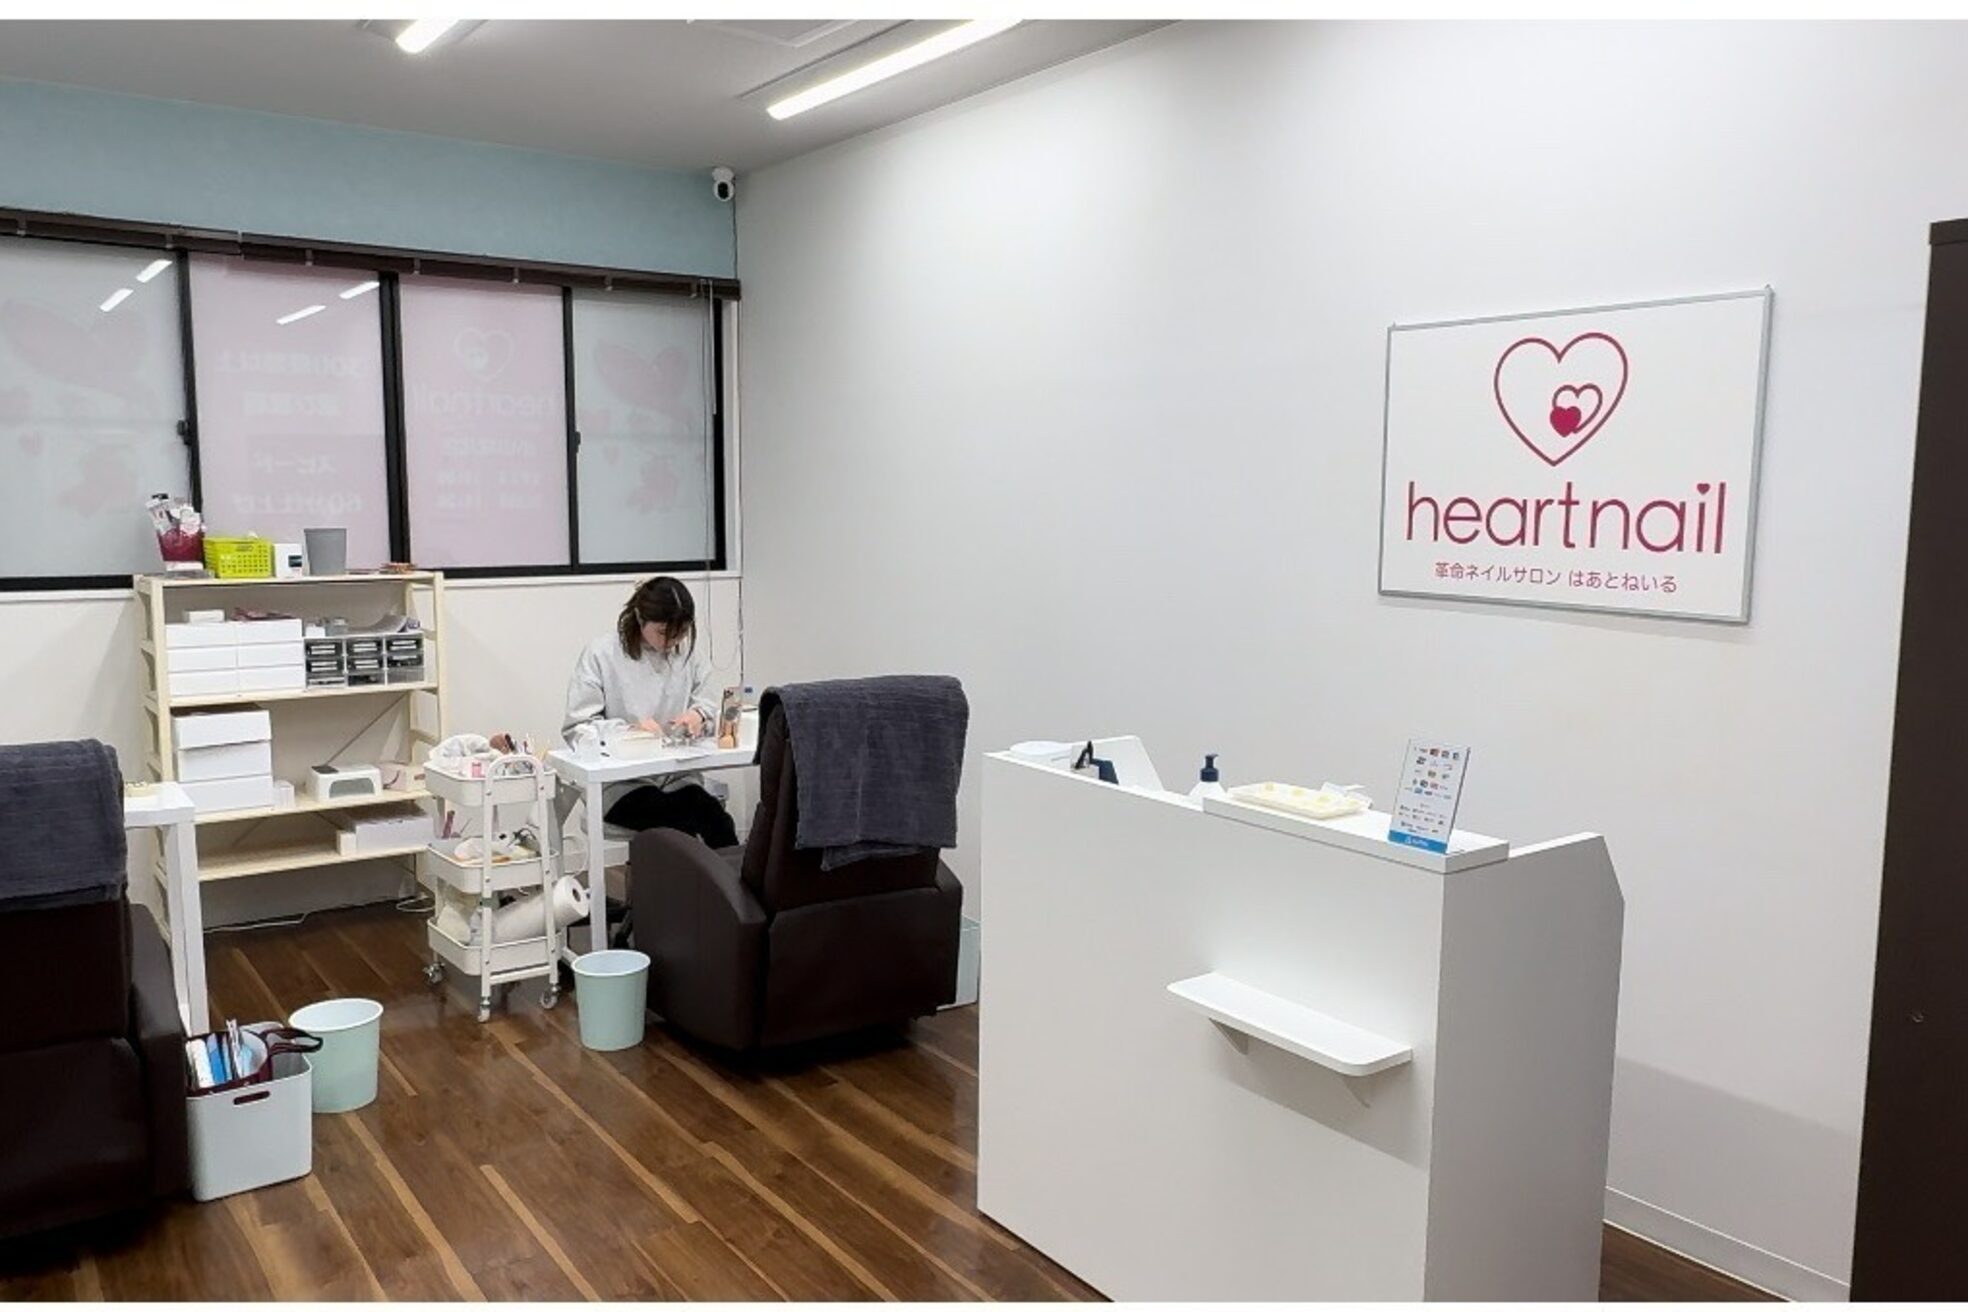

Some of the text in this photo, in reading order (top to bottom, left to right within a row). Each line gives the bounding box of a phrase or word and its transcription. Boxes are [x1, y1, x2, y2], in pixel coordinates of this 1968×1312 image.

[1405, 481, 1727, 554] heartnail
[1435, 561, 1678, 594] 革命ネイルサロン はあとねいる
